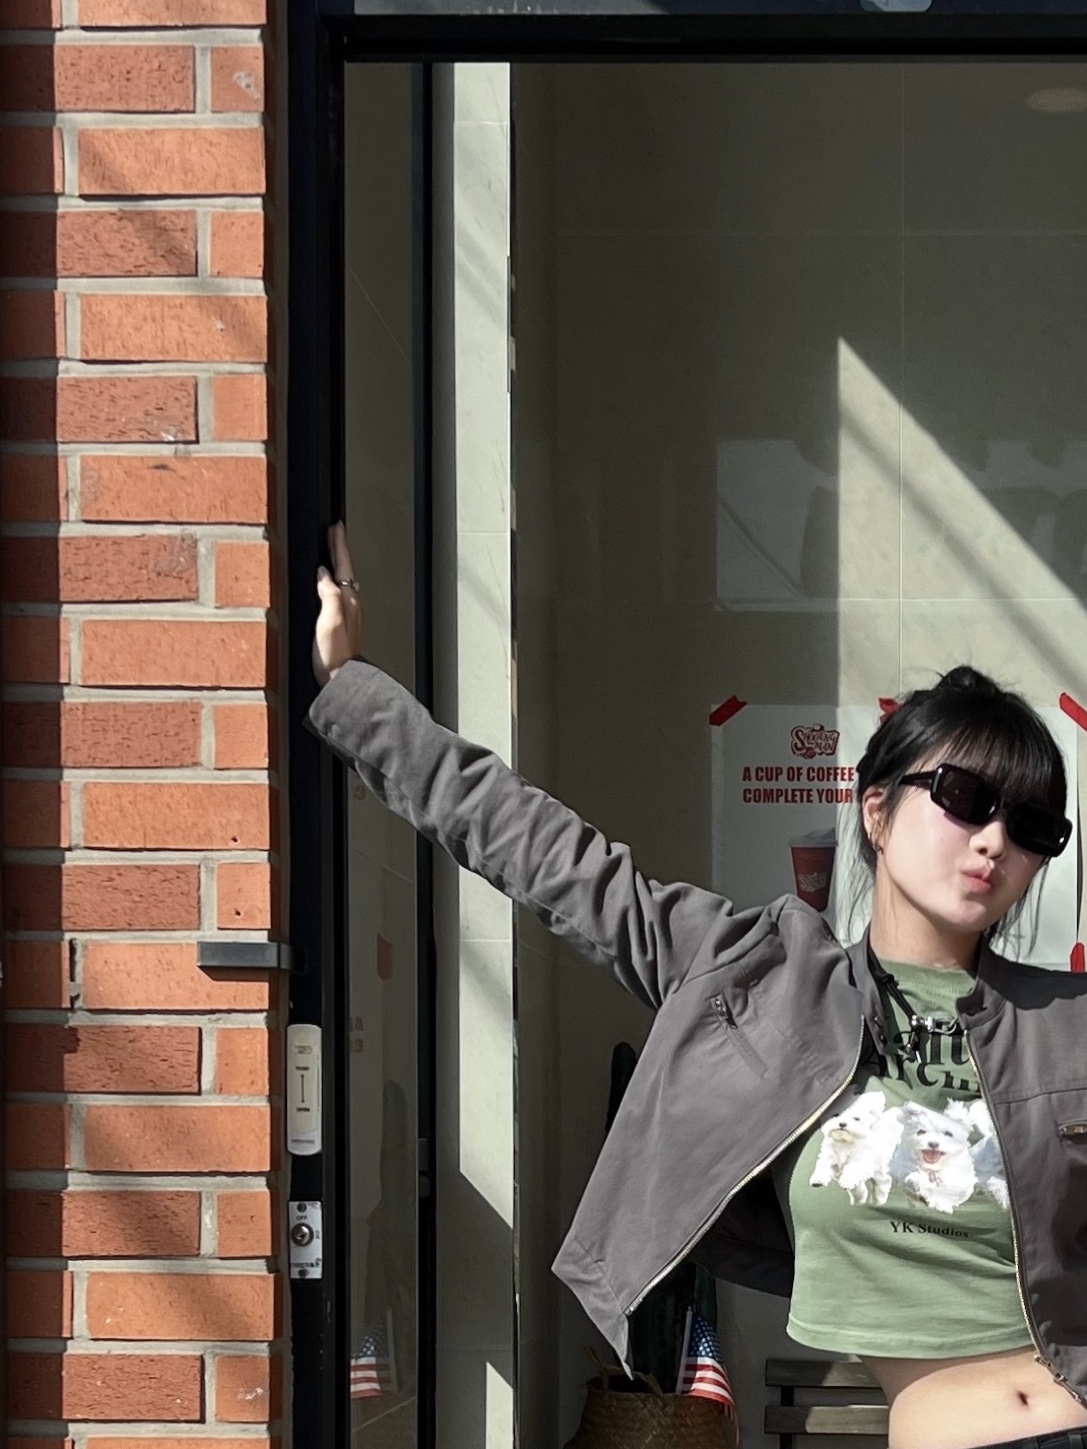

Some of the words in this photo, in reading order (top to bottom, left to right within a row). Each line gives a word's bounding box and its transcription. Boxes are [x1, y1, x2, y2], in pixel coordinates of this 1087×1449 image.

[742, 766, 752, 782] A
[755, 766, 784, 782] CUP
[786, 766, 804, 782] OF
[806, 766, 855, 782] COFFEE
[742, 788, 814, 804] COMPLETE
[816, 788, 854, 804] YOUR
[890, 1221, 914, 1234] YK
[917, 1223, 970, 1239] Studios
